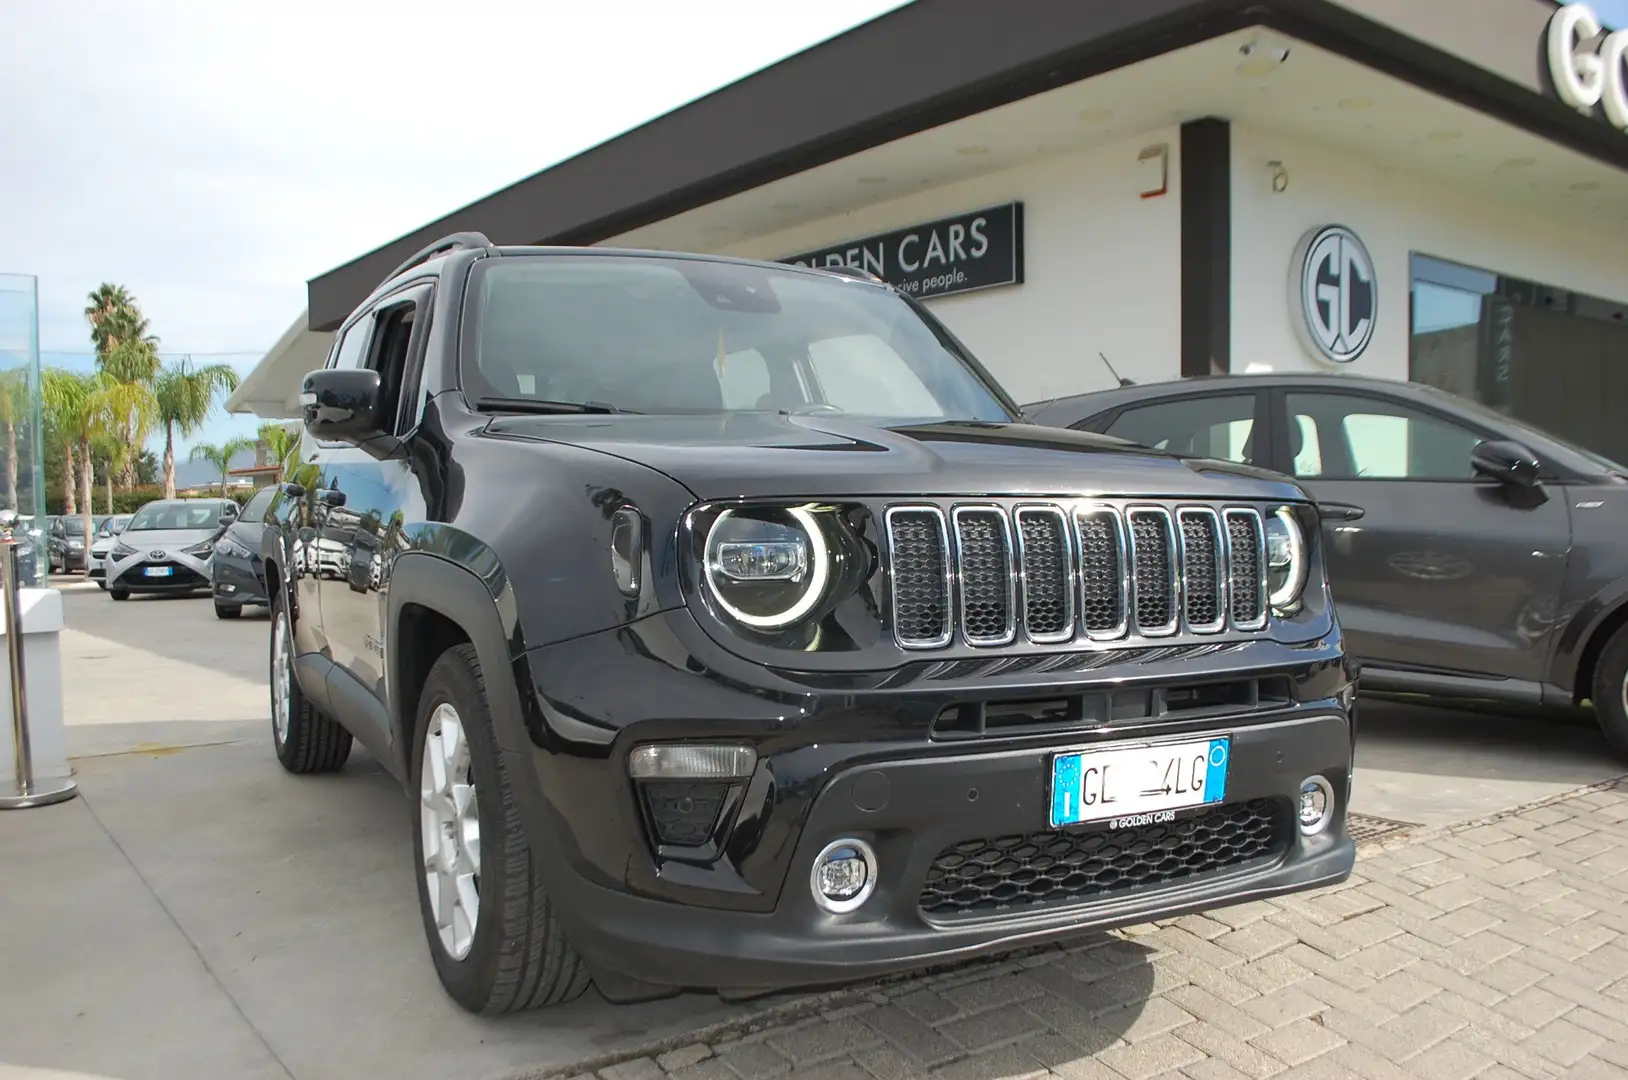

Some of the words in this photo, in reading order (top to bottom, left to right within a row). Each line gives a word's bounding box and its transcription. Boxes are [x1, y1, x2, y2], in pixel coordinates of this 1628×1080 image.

[898, 217, 989, 273] CARS
[922, 269, 968, 294] people.
[1119, 815, 1153, 828] GOLDEN
[1154, 811, 1176, 823] CARS
